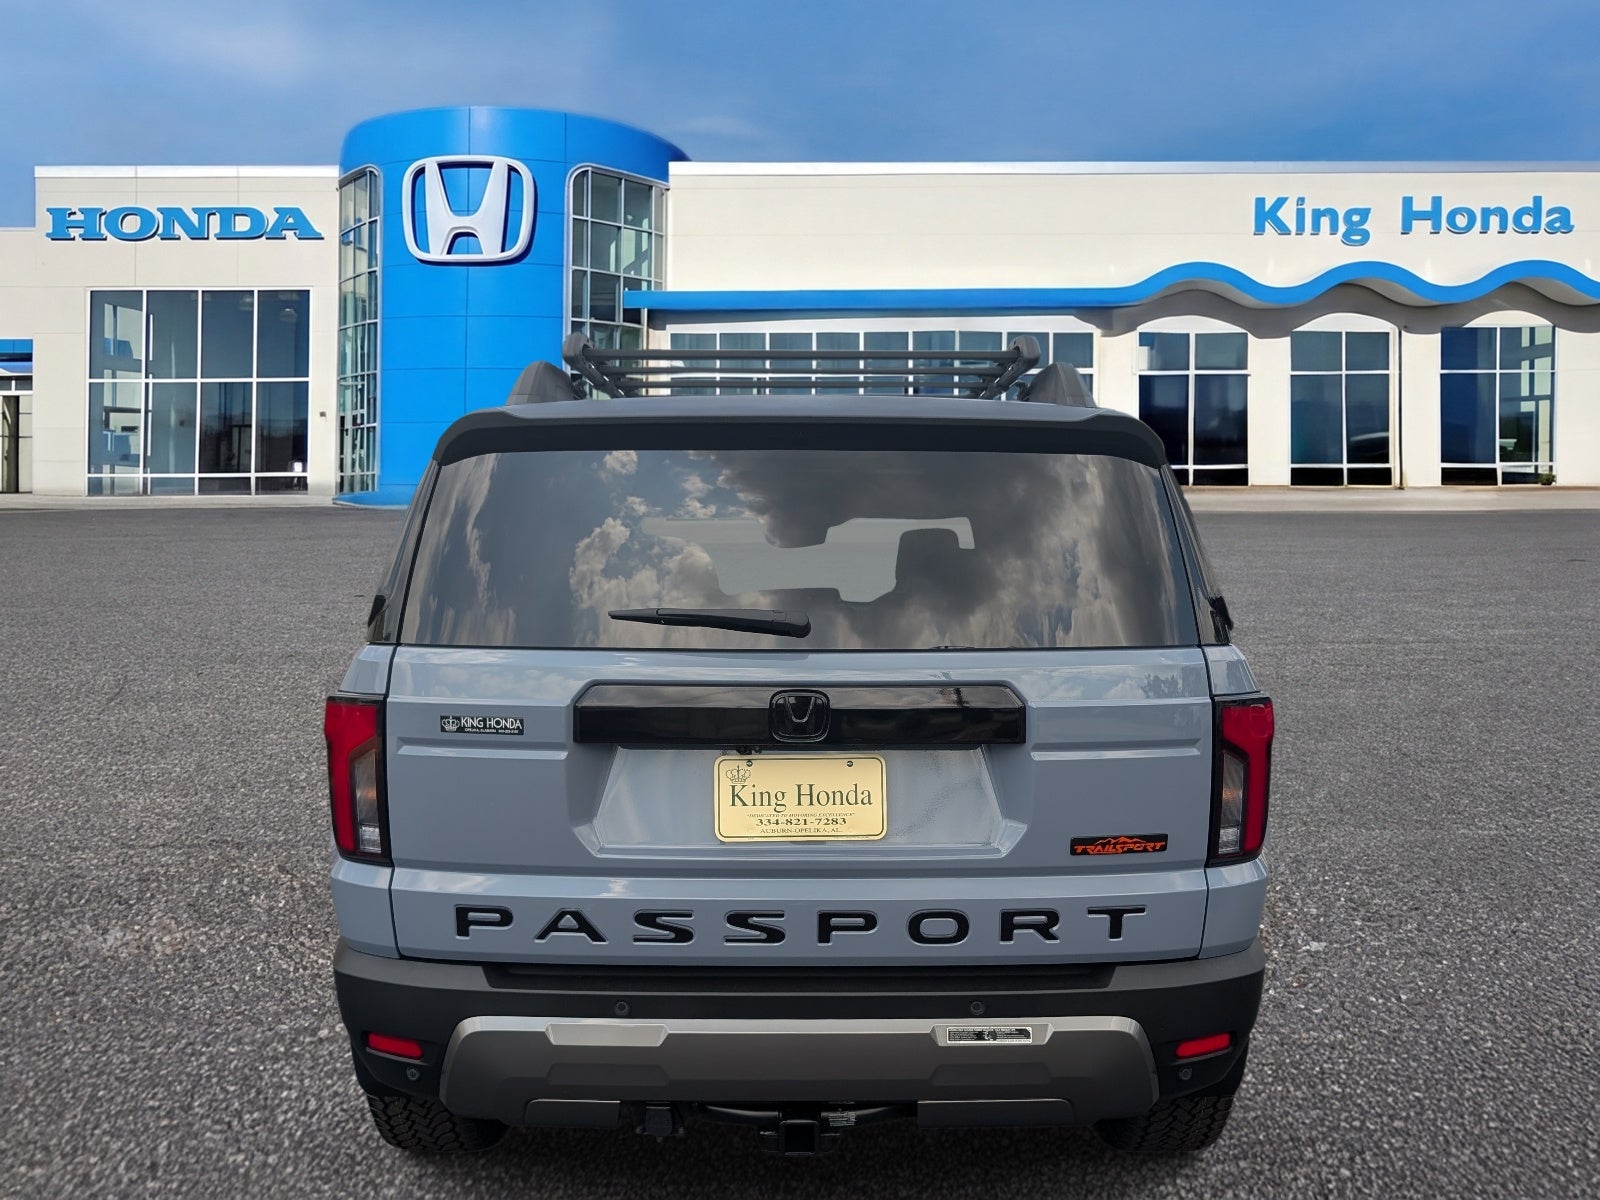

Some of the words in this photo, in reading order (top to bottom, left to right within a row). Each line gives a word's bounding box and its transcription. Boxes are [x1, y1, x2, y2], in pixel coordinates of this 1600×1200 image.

[45, 206, 325, 242] HONDA
[1253, 196, 1373, 247] King
[1400, 195, 1575, 236] Honda
[461, 716, 484, 728] KING
[486, 717, 522, 729] HONDA
[729, 784, 787, 813] King
[795, 783, 873, 807] Honda
[756, 818, 847, 826] 334-821-7283
[1074, 841, 1166, 855] TRAILSPORT
[453, 904, 1148, 945] PASSPORT
